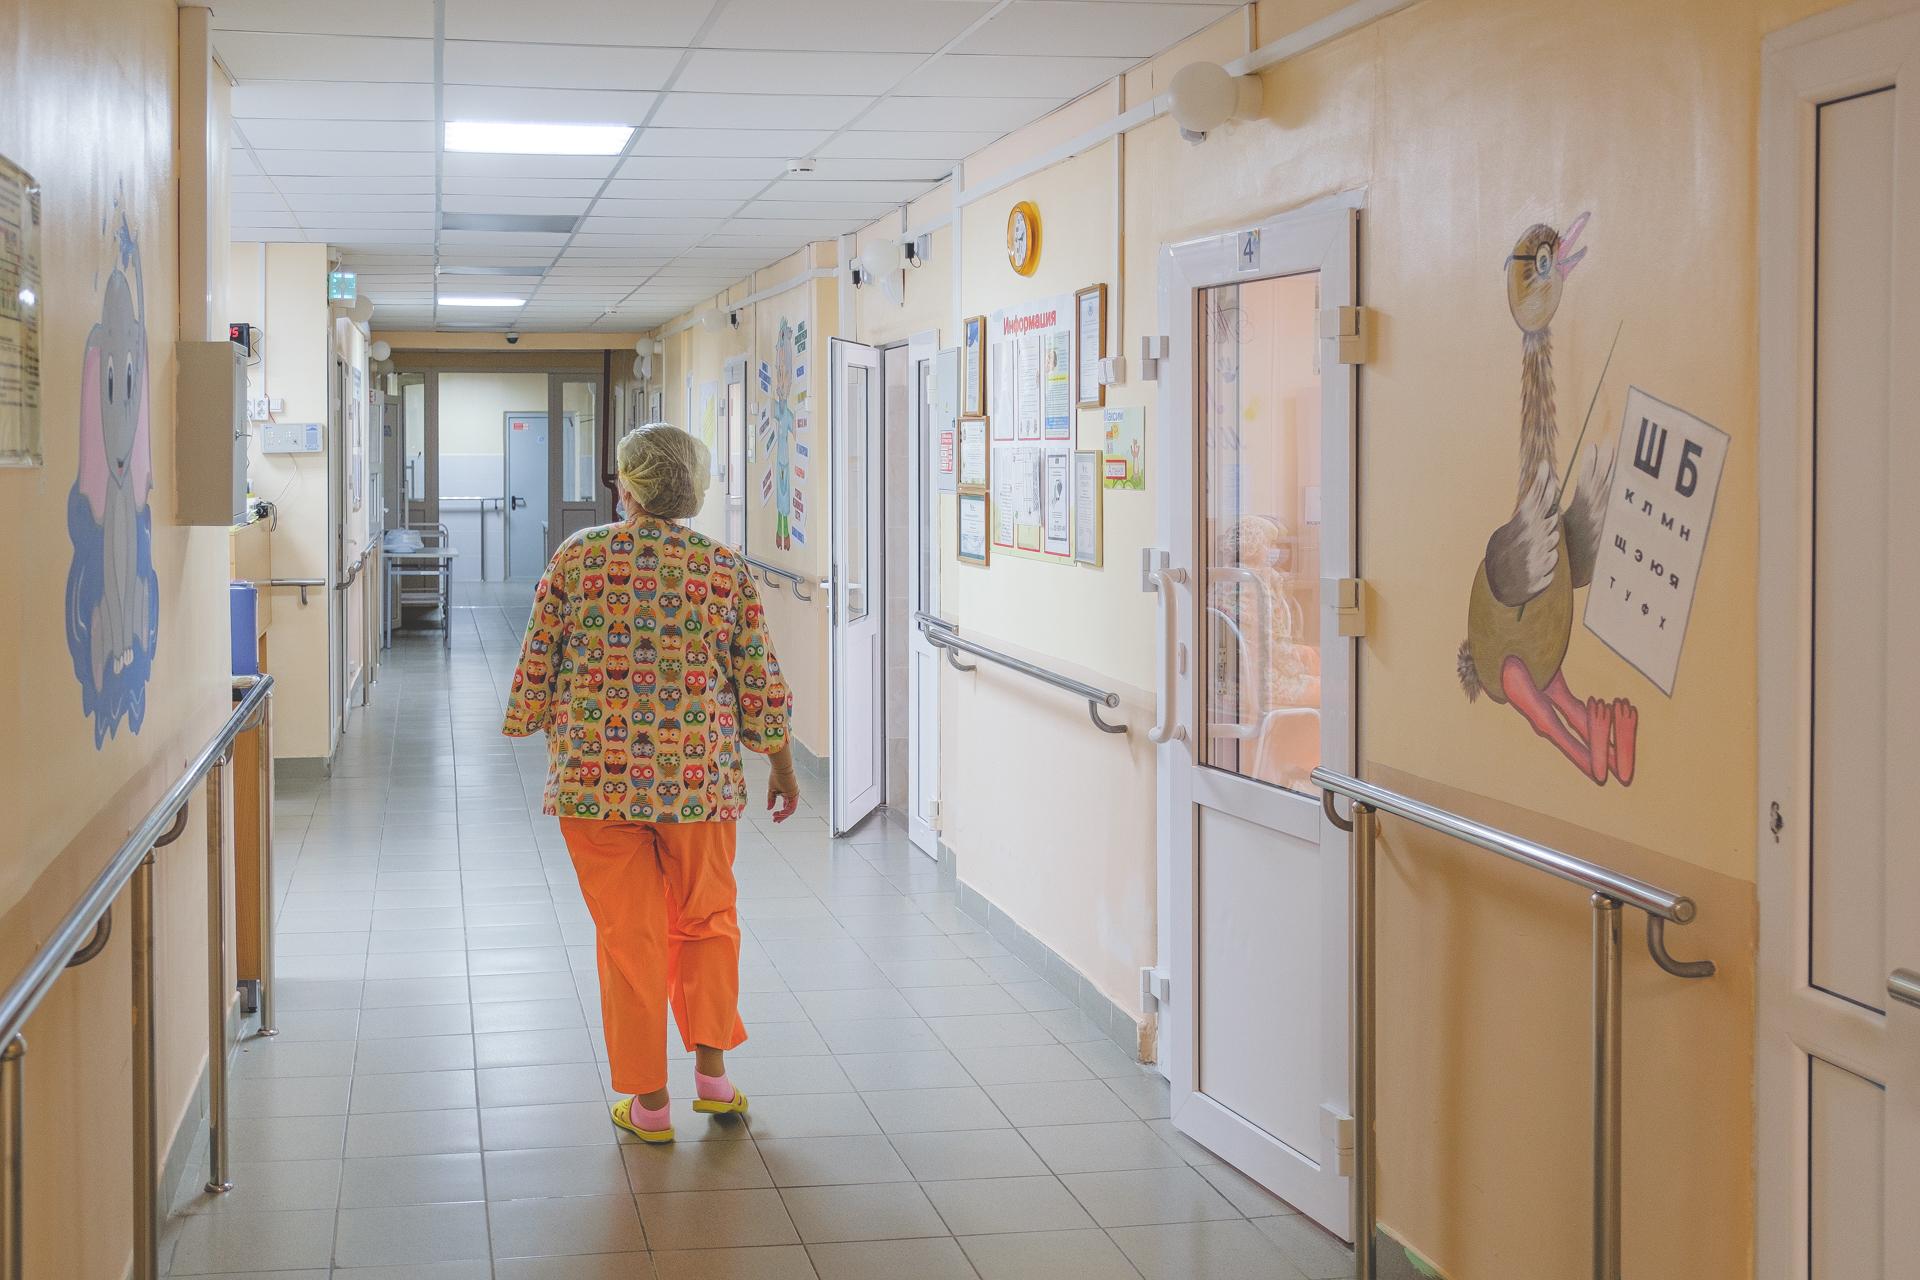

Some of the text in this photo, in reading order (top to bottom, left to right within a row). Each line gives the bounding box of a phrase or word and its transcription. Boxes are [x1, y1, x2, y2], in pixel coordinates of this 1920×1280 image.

[1243, 236, 1254, 264] 4
[1003, 310, 1057, 336] Информация
[1633, 416, 1703, 498] Ш Б
